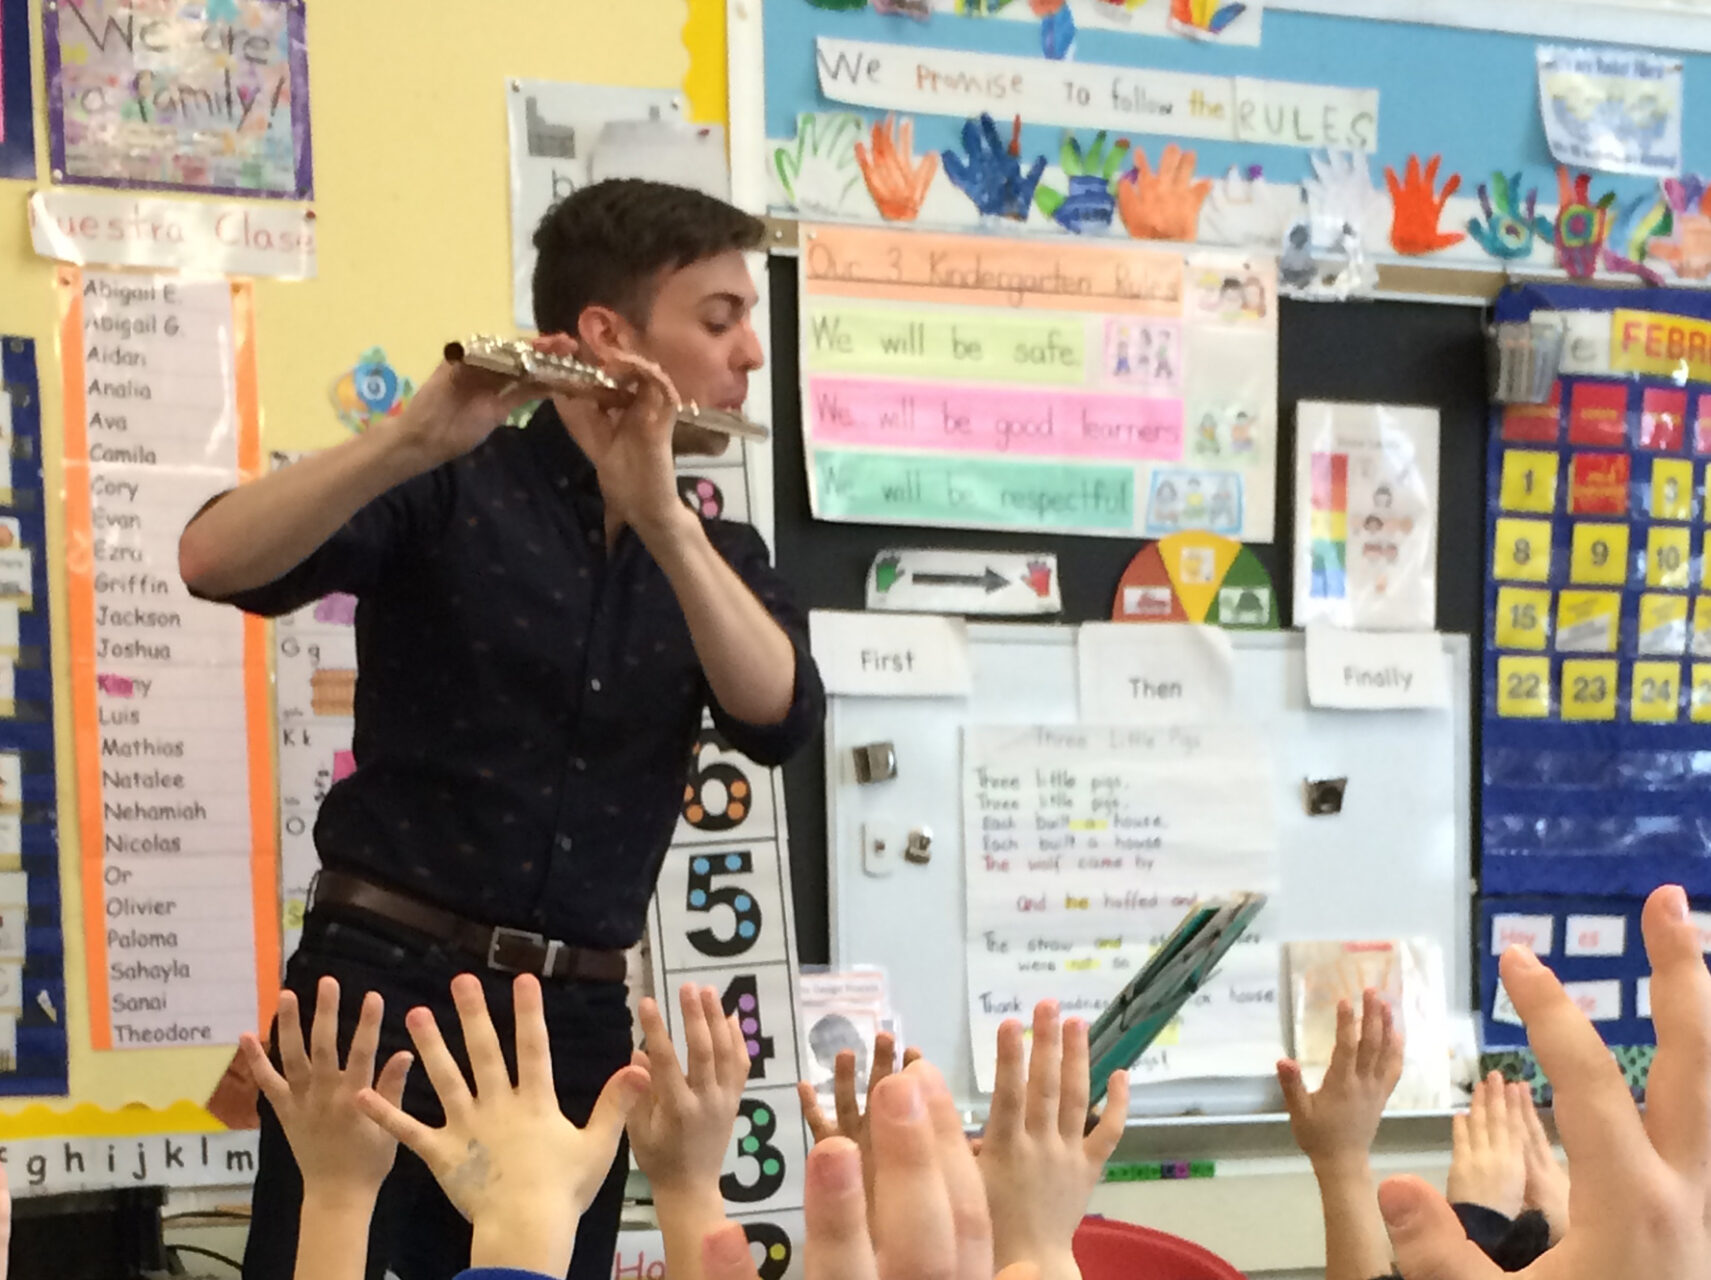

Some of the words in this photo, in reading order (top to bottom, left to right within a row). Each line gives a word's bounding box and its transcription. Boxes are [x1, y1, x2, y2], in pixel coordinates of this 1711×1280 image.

[816, 51, 881, 84] We
[1189, 88, 1226, 120] the
[1238, 99, 1374, 148] RULES
[812, 315, 854, 353] We
[880, 321, 925, 356] will
[951, 325, 984, 360] be
[1012, 328, 1080, 366] safe
[89, 412, 127, 431] Ava
[817, 393, 854, 427] We
[880, 396, 916, 431] will
[943, 401, 972, 434] be
[996, 406, 1054, 452] good
[1082, 408, 1180, 440] learners
[90, 443, 157, 465] Camila
[91, 475, 139, 501] Cory
[881, 470, 921, 503] will
[1512, 537, 1532, 566] 8
[1590, 540, 1609, 567] 9
[1656, 546, 1681, 572] 10
[94, 573, 168, 594] Griffin
[96, 605, 181, 627] Jackson
[97, 638, 171, 660] Joshua
[860, 649, 915, 673] First
[1128, 677, 1183, 700] Then
[1343, 665, 1414, 692] Finally
[1507, 673, 1541, 700] 22
[1573, 675, 1607, 703] 23
[98, 707, 140, 725] Luis
[101, 738, 185, 757] Mathias
[682, 728, 751, 832] 6
[105, 833, 181, 852] Nicolas
[104, 866, 133, 885] Or
[106, 896, 176, 918] Olivier
[685, 851, 763, 957] 5
[107, 929, 178, 948] Paloma
[114, 1022, 211, 1043] Theodore
[27, 1154, 47, 1185] g
[64, 1142, 84, 1173] h
[106, 1144, 116, 1172] i
[132, 1142, 147, 1180] j
[165, 1138, 185, 1168] k
[226, 1149, 254, 1171] m
[718, 1098, 787, 1203] 3
